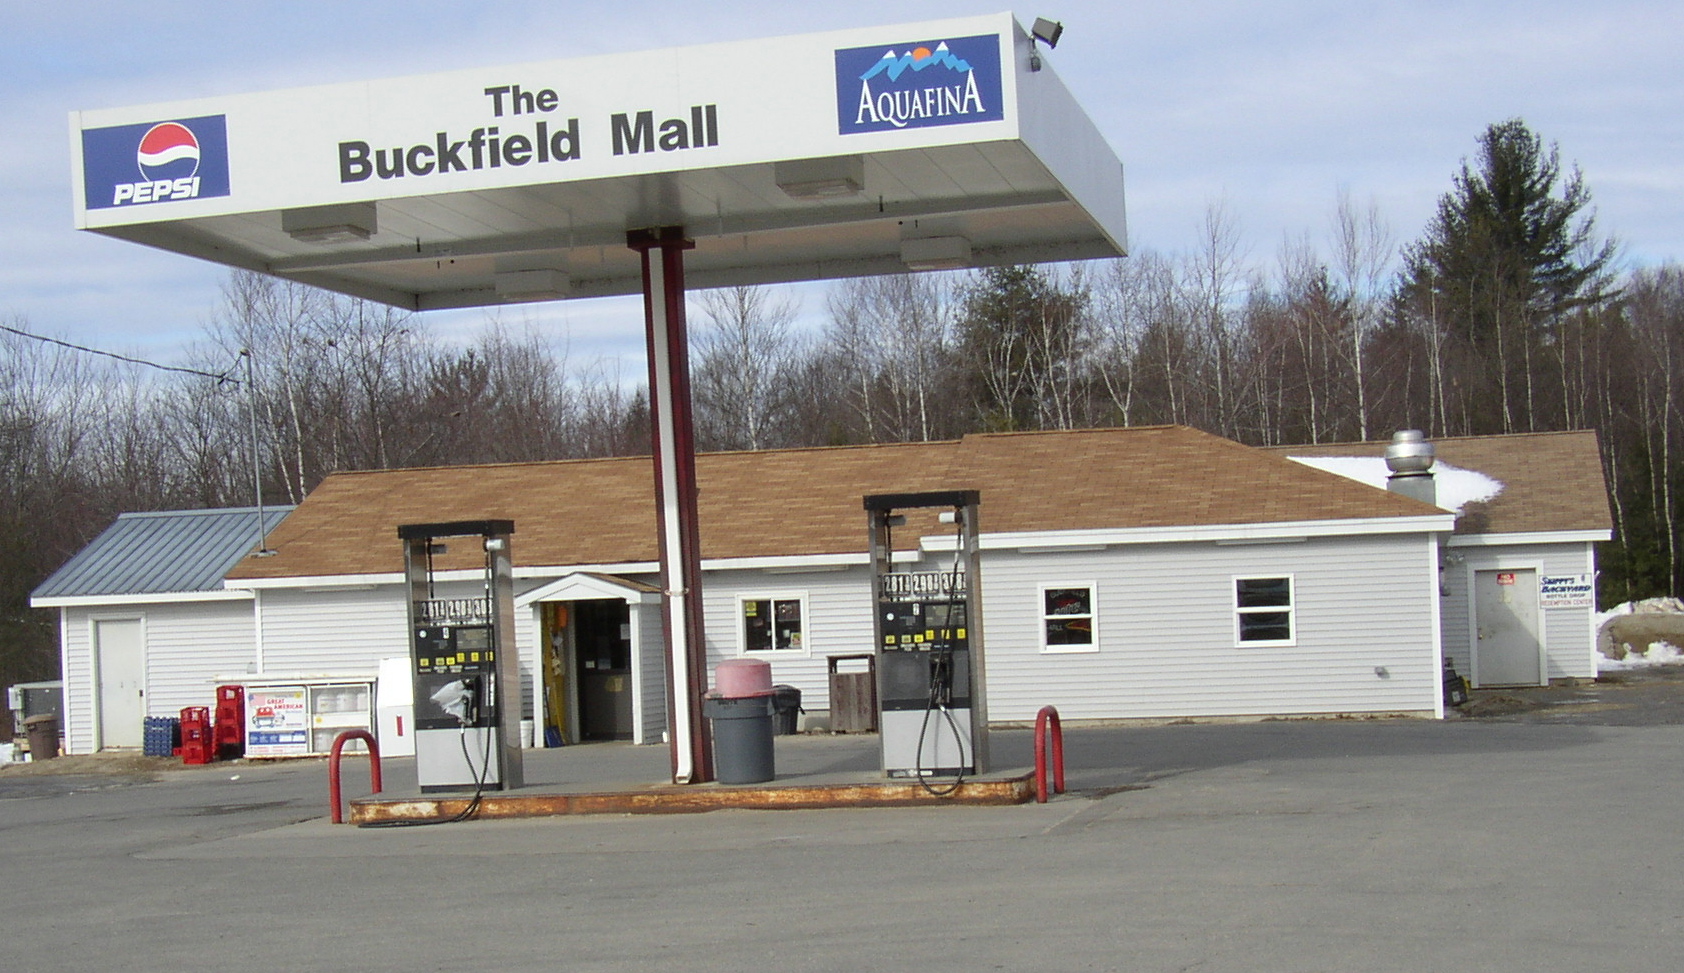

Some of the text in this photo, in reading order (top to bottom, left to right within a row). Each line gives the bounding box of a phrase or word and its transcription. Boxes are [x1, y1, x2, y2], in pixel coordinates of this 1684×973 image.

[484, 85, 559, 117] The
[855, 69, 986, 127] AQUAFINA
[338, 104, 719, 184] Buckfield Mall
[113, 176, 201, 205] PEPSI
